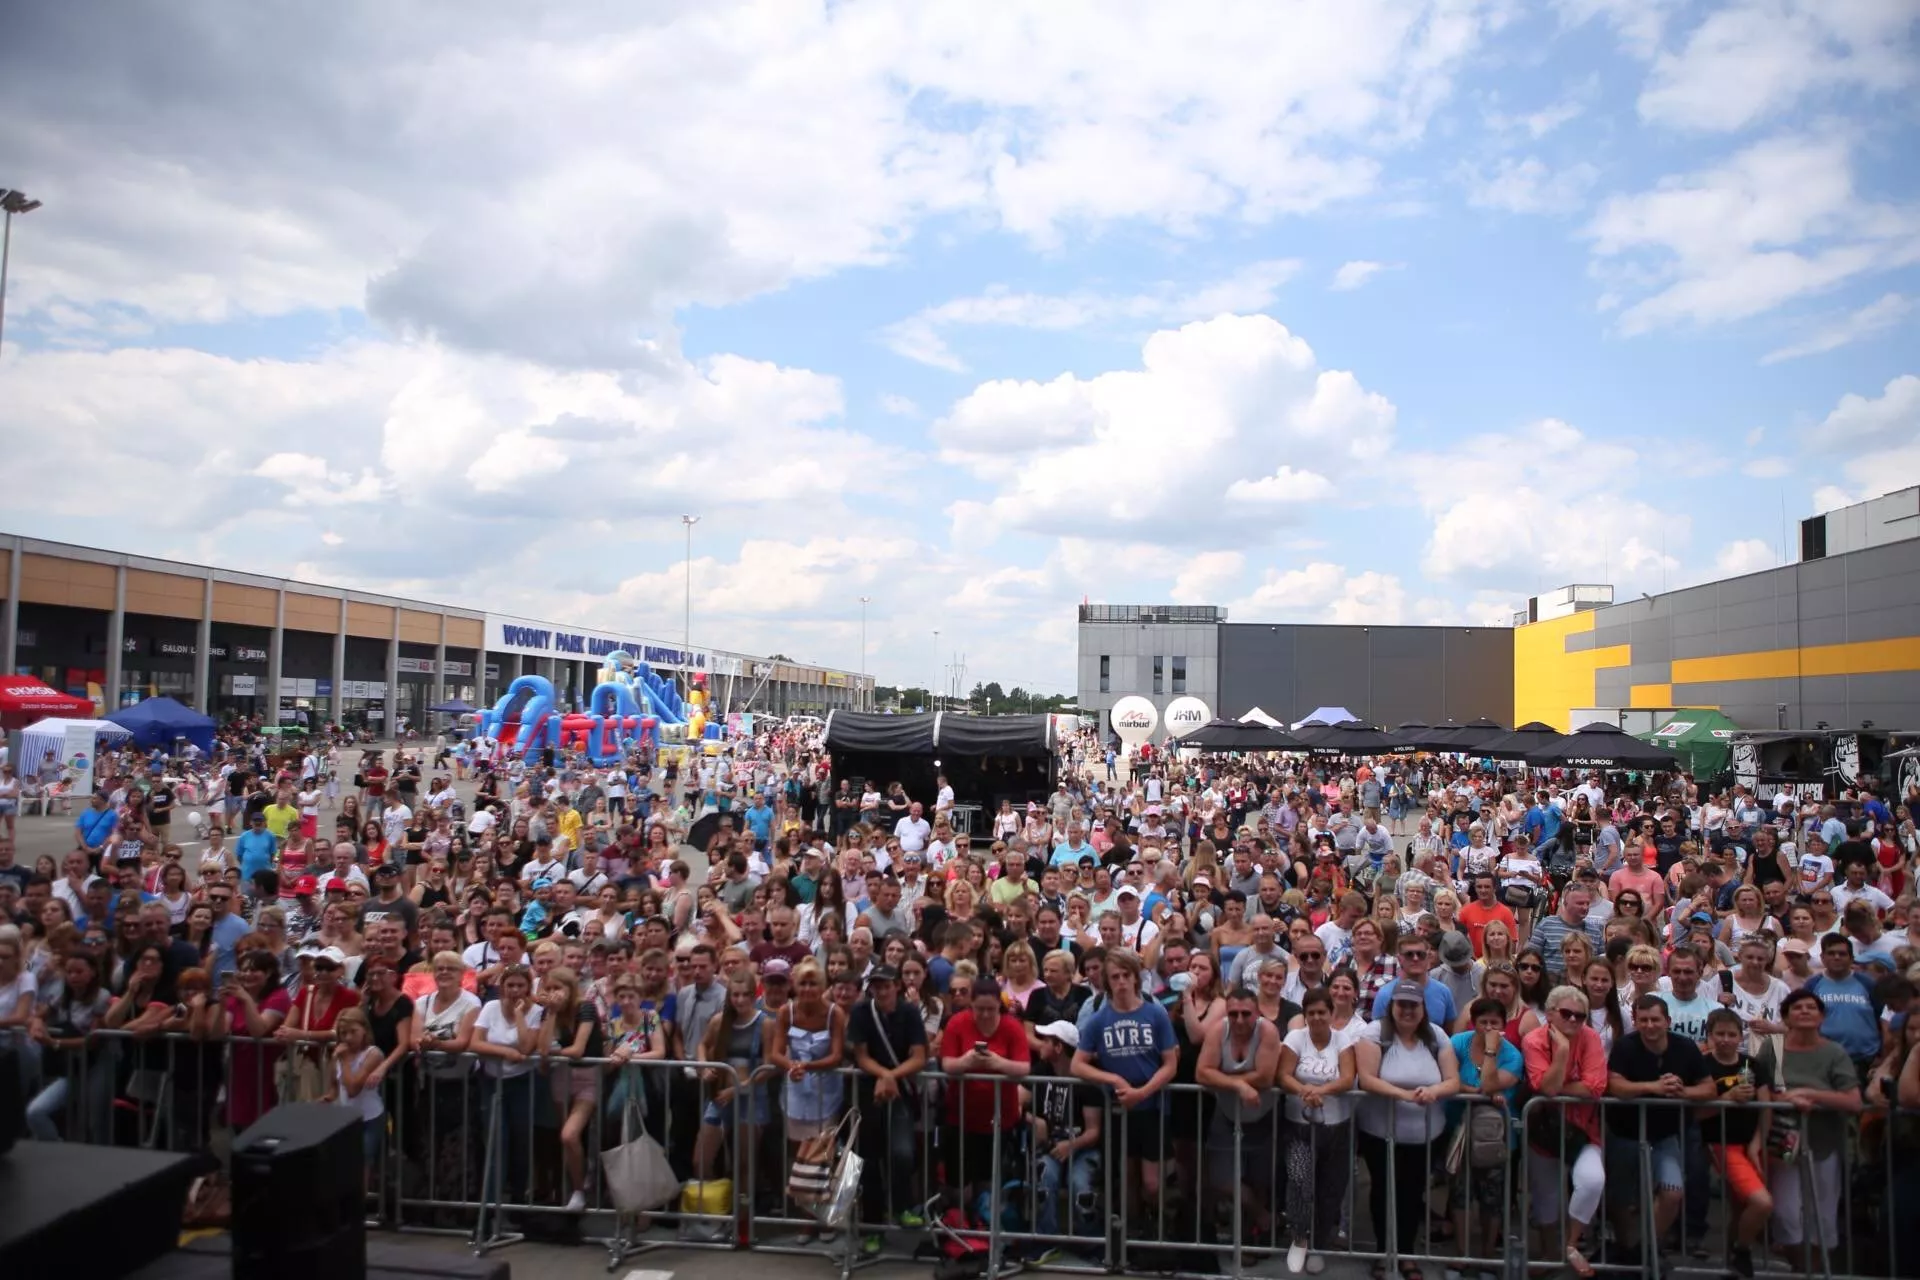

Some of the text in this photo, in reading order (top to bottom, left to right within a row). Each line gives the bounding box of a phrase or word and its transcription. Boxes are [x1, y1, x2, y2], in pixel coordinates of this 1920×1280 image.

[556, 632, 586, 653] PARK
[162, 644, 188, 654] SALON
[1119, 720, 1150, 728] mirbud
[1575, 757, 1589, 765] PÓŁ
[1590, 758, 1613, 766] DROGI
